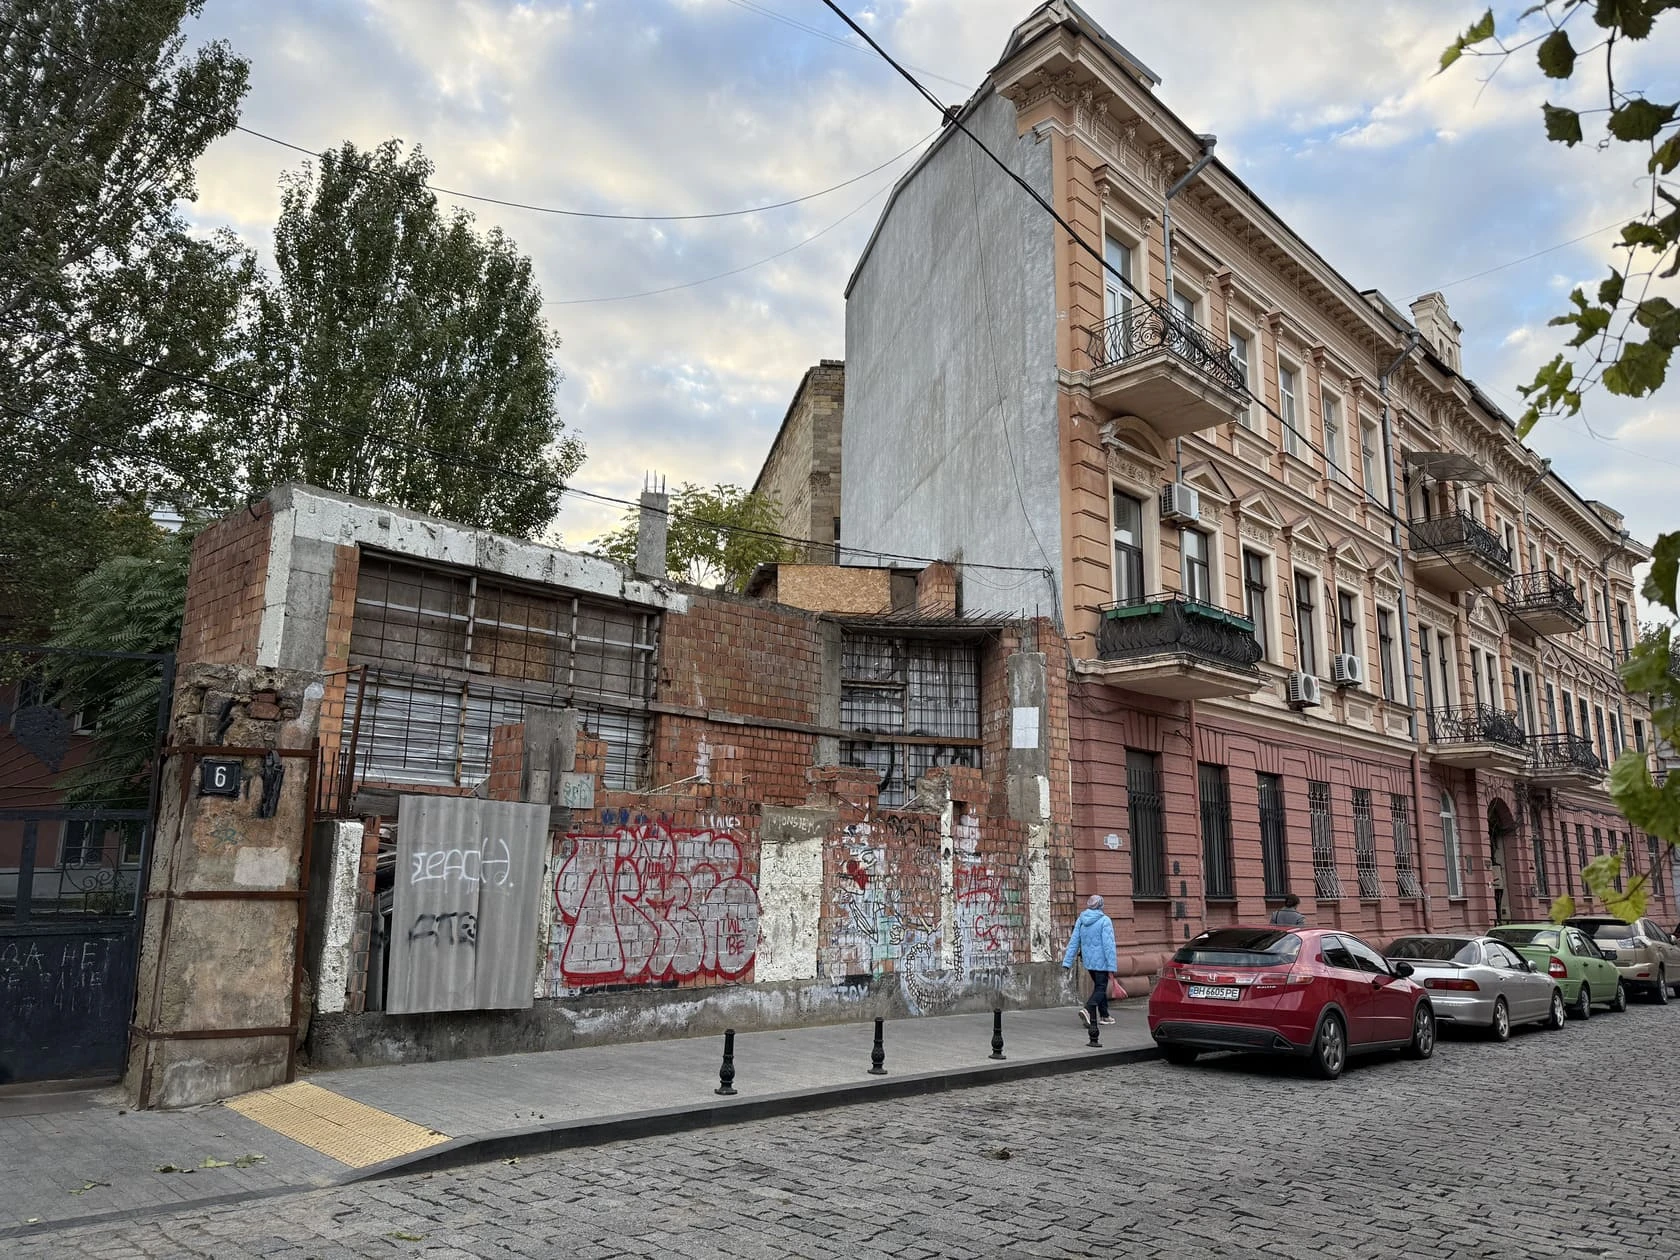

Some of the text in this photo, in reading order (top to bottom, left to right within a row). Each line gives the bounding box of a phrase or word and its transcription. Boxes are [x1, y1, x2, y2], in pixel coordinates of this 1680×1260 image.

[215, 766, 227, 788] 6
[1193, 986, 1238, 998] BH 6605 PE
